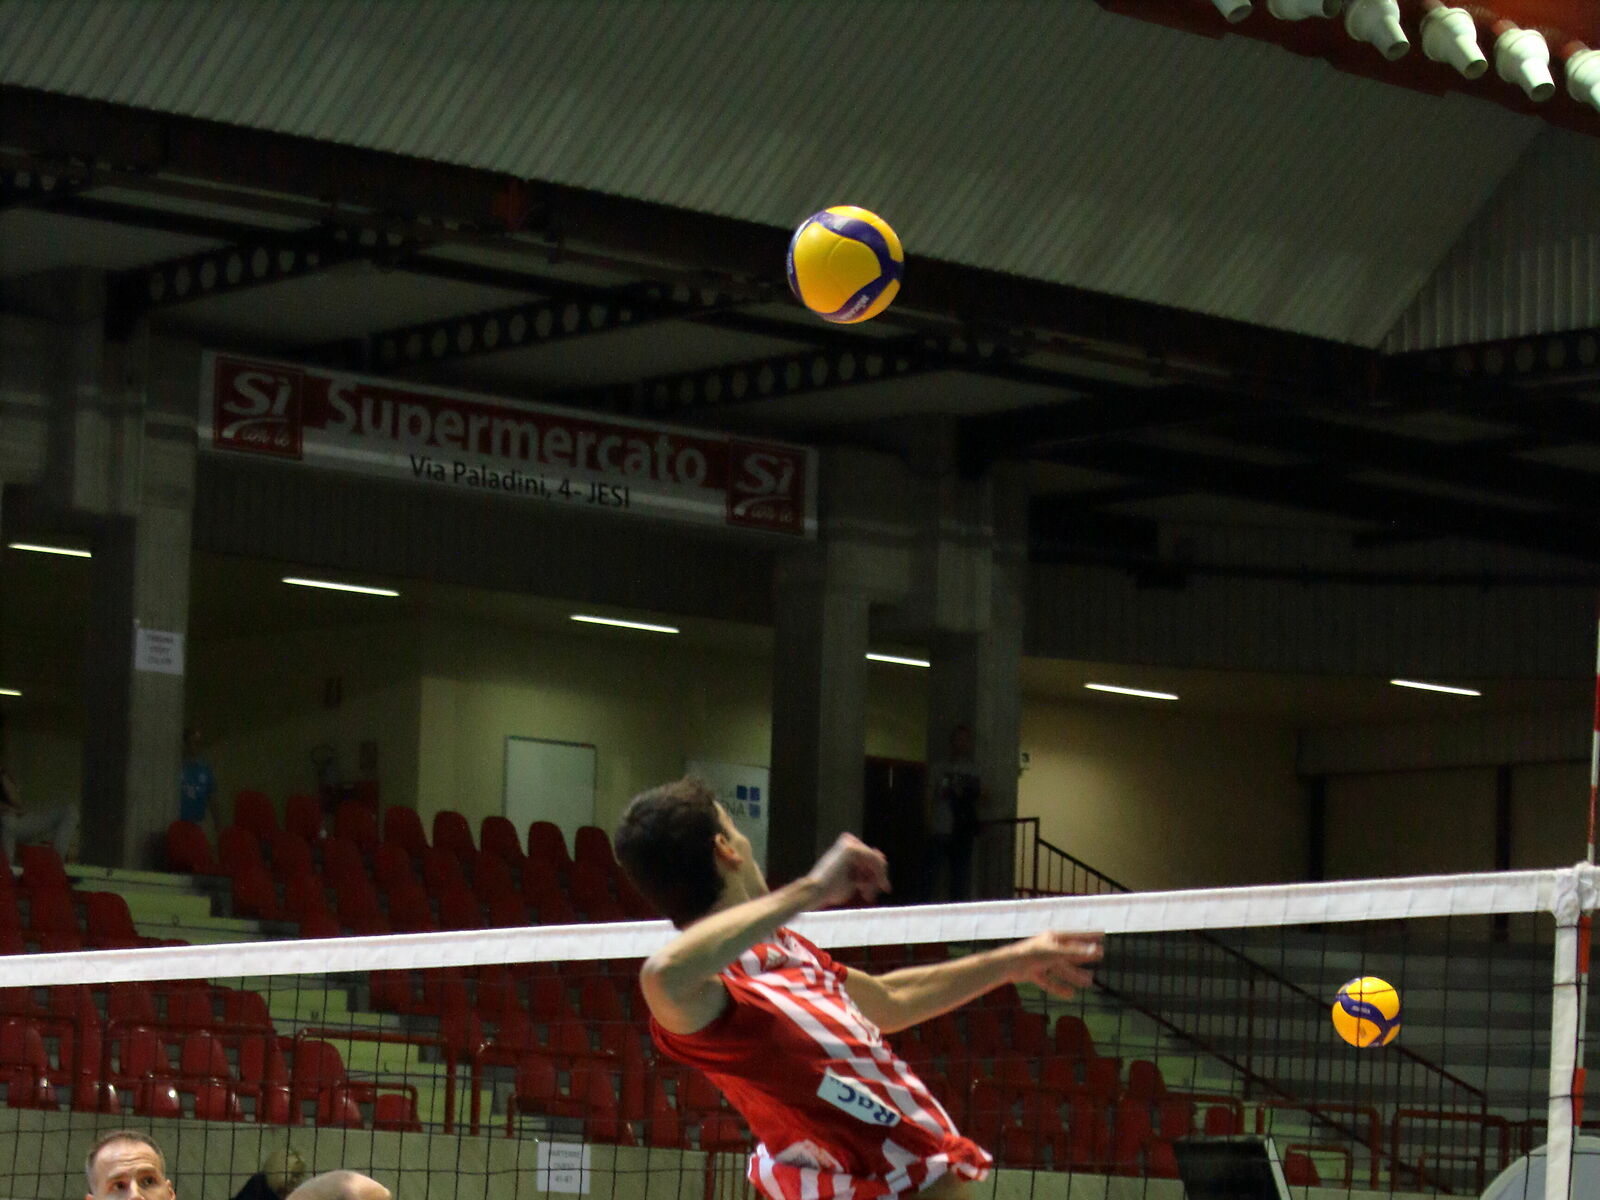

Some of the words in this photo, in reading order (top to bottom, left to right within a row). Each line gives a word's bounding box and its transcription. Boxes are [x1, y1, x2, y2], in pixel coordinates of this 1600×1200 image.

[327, 378, 707, 488] Supermercato
[409, 454, 446, 482] Via
[453, 460, 551, 501] Paladini,
[586, 481, 630, 509] JESI
